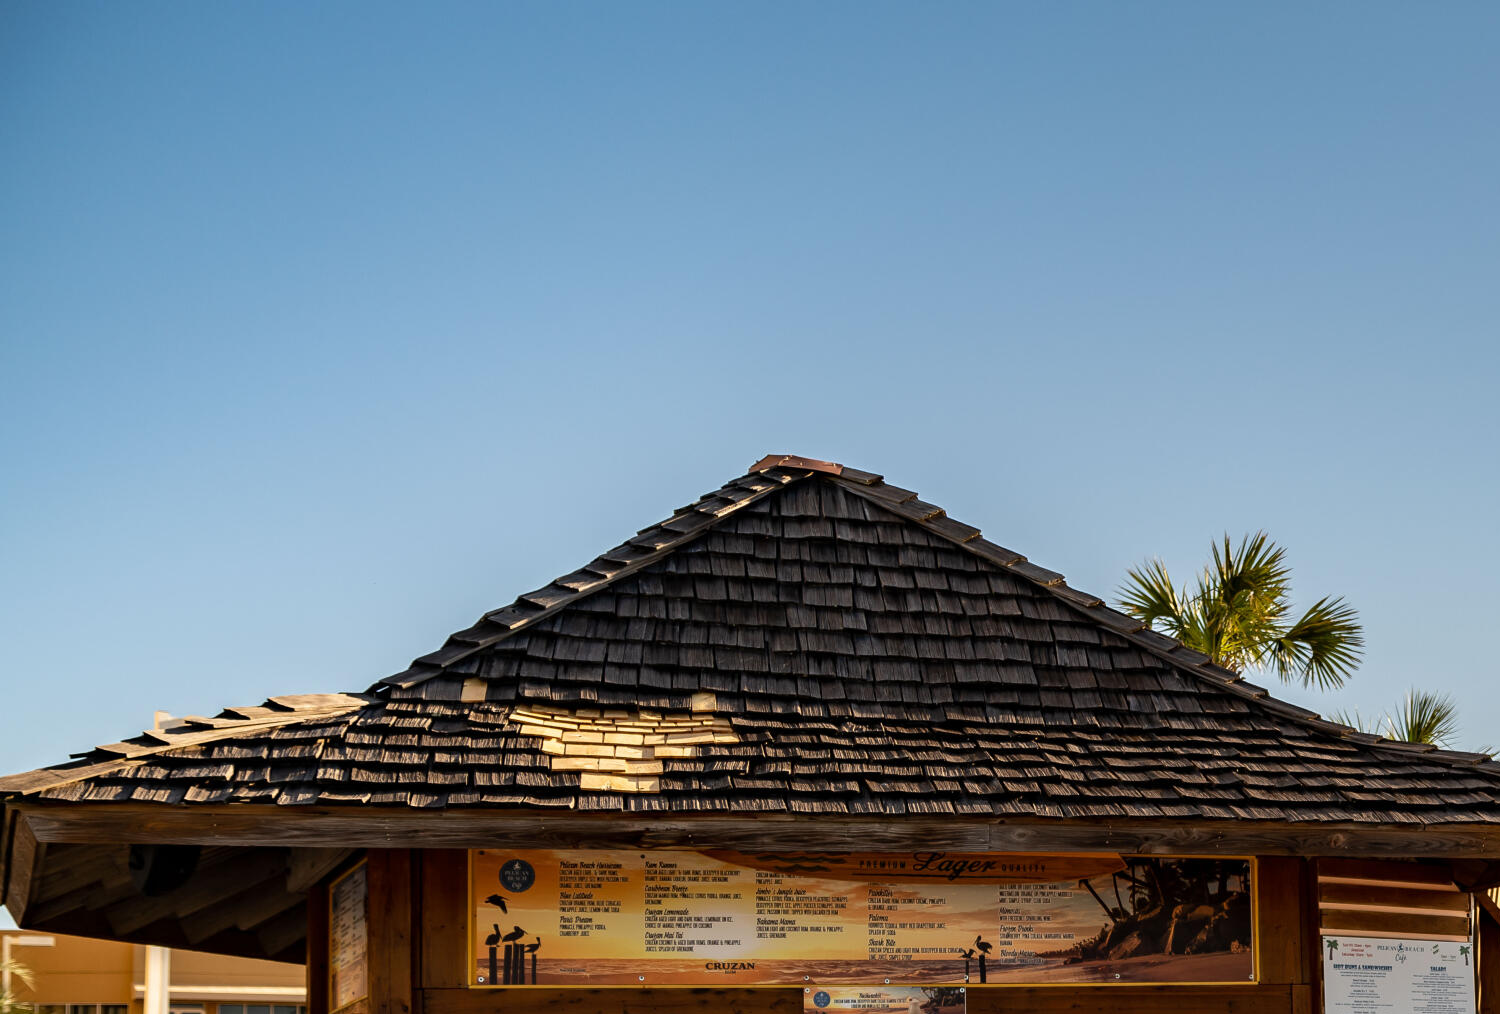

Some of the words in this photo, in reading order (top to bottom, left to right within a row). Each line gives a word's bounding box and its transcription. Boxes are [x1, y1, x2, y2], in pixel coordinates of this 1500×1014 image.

[912, 852, 997, 880] Lager
[1001, 864, 1046, 872] QUALITY
[705, 962, 755, 970] CRUZAN
